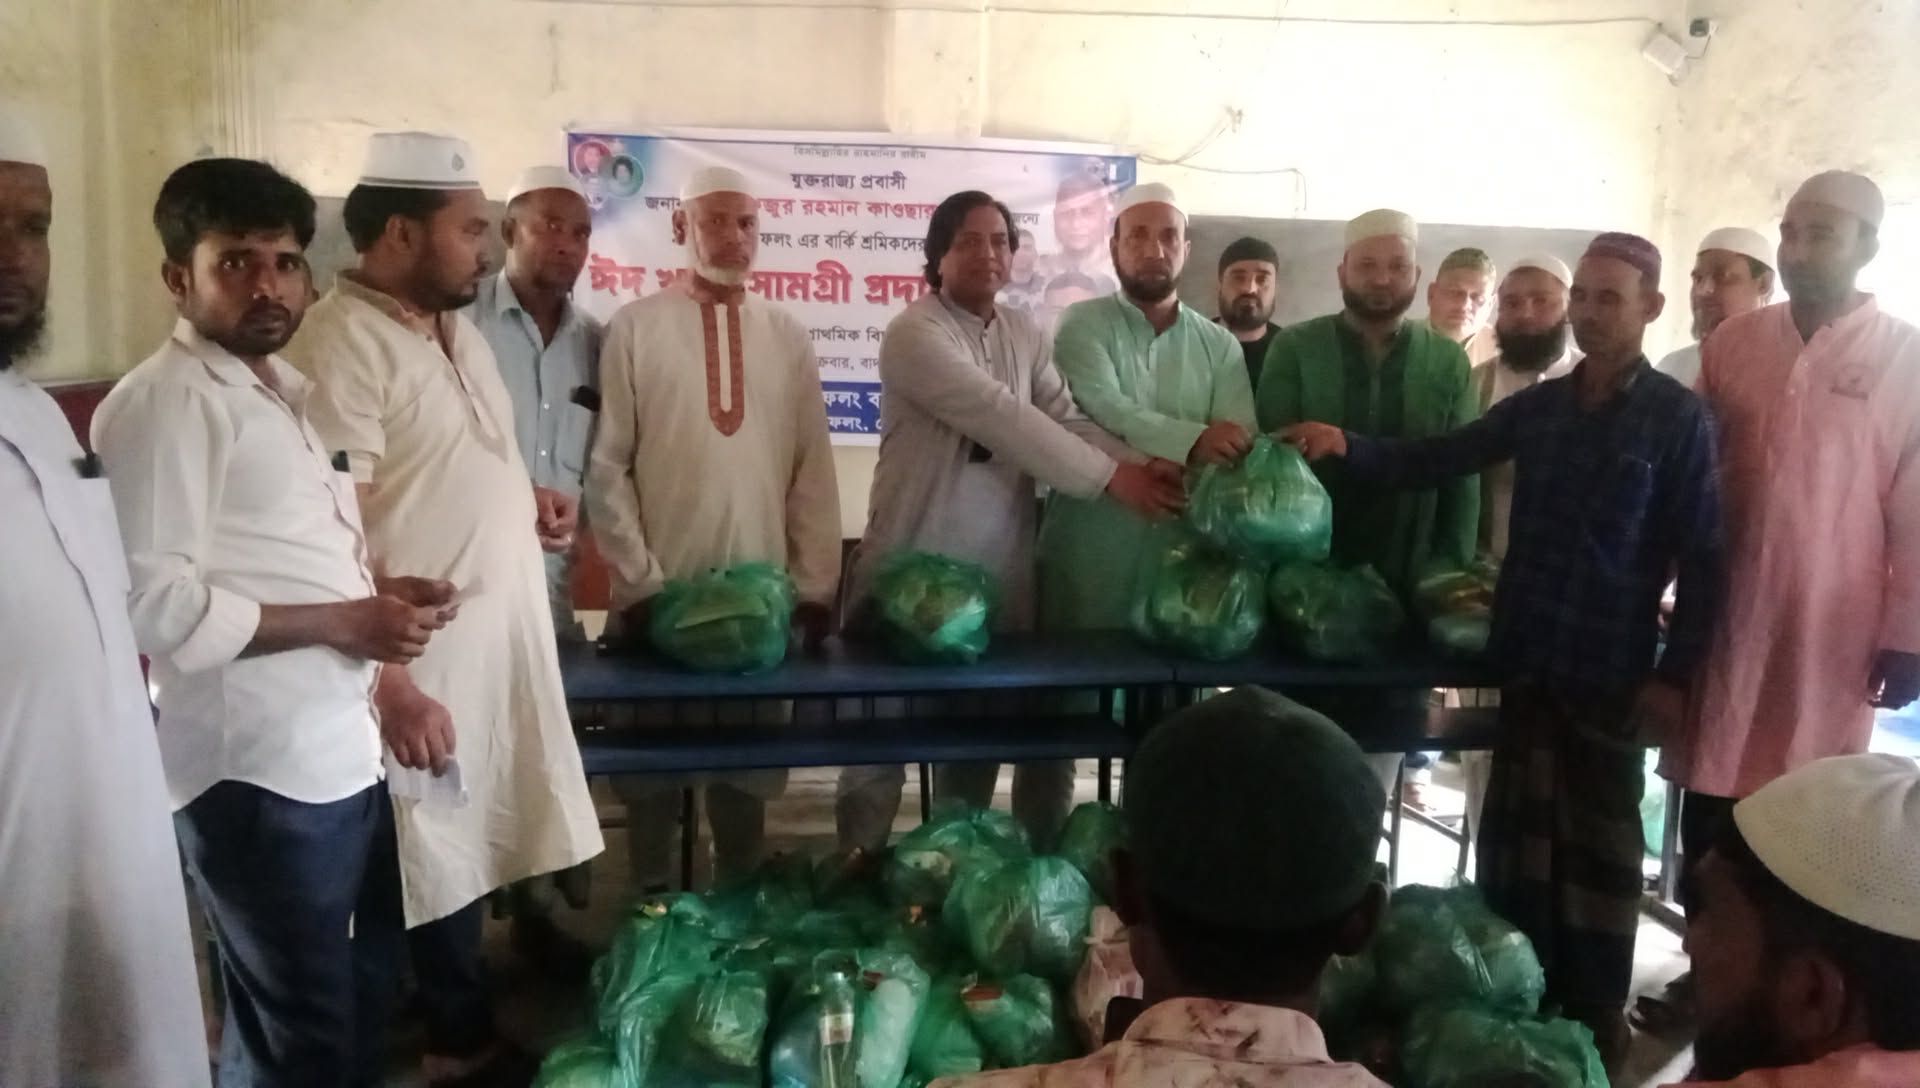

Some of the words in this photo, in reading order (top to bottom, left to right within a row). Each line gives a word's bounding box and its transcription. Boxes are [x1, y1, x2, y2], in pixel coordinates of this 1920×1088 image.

[790, 173, 857, 190] যুক্তরাজ্য
[860, 170, 908, 190] প্রবাসী
[644, 196, 681, 211] জনা
[801, 199, 860, 216] রহমান
[798, 234, 820, 248] এর
[748, 259, 853, 304] সামগ্রী
[864, 274, 929, 306] প্রদা
